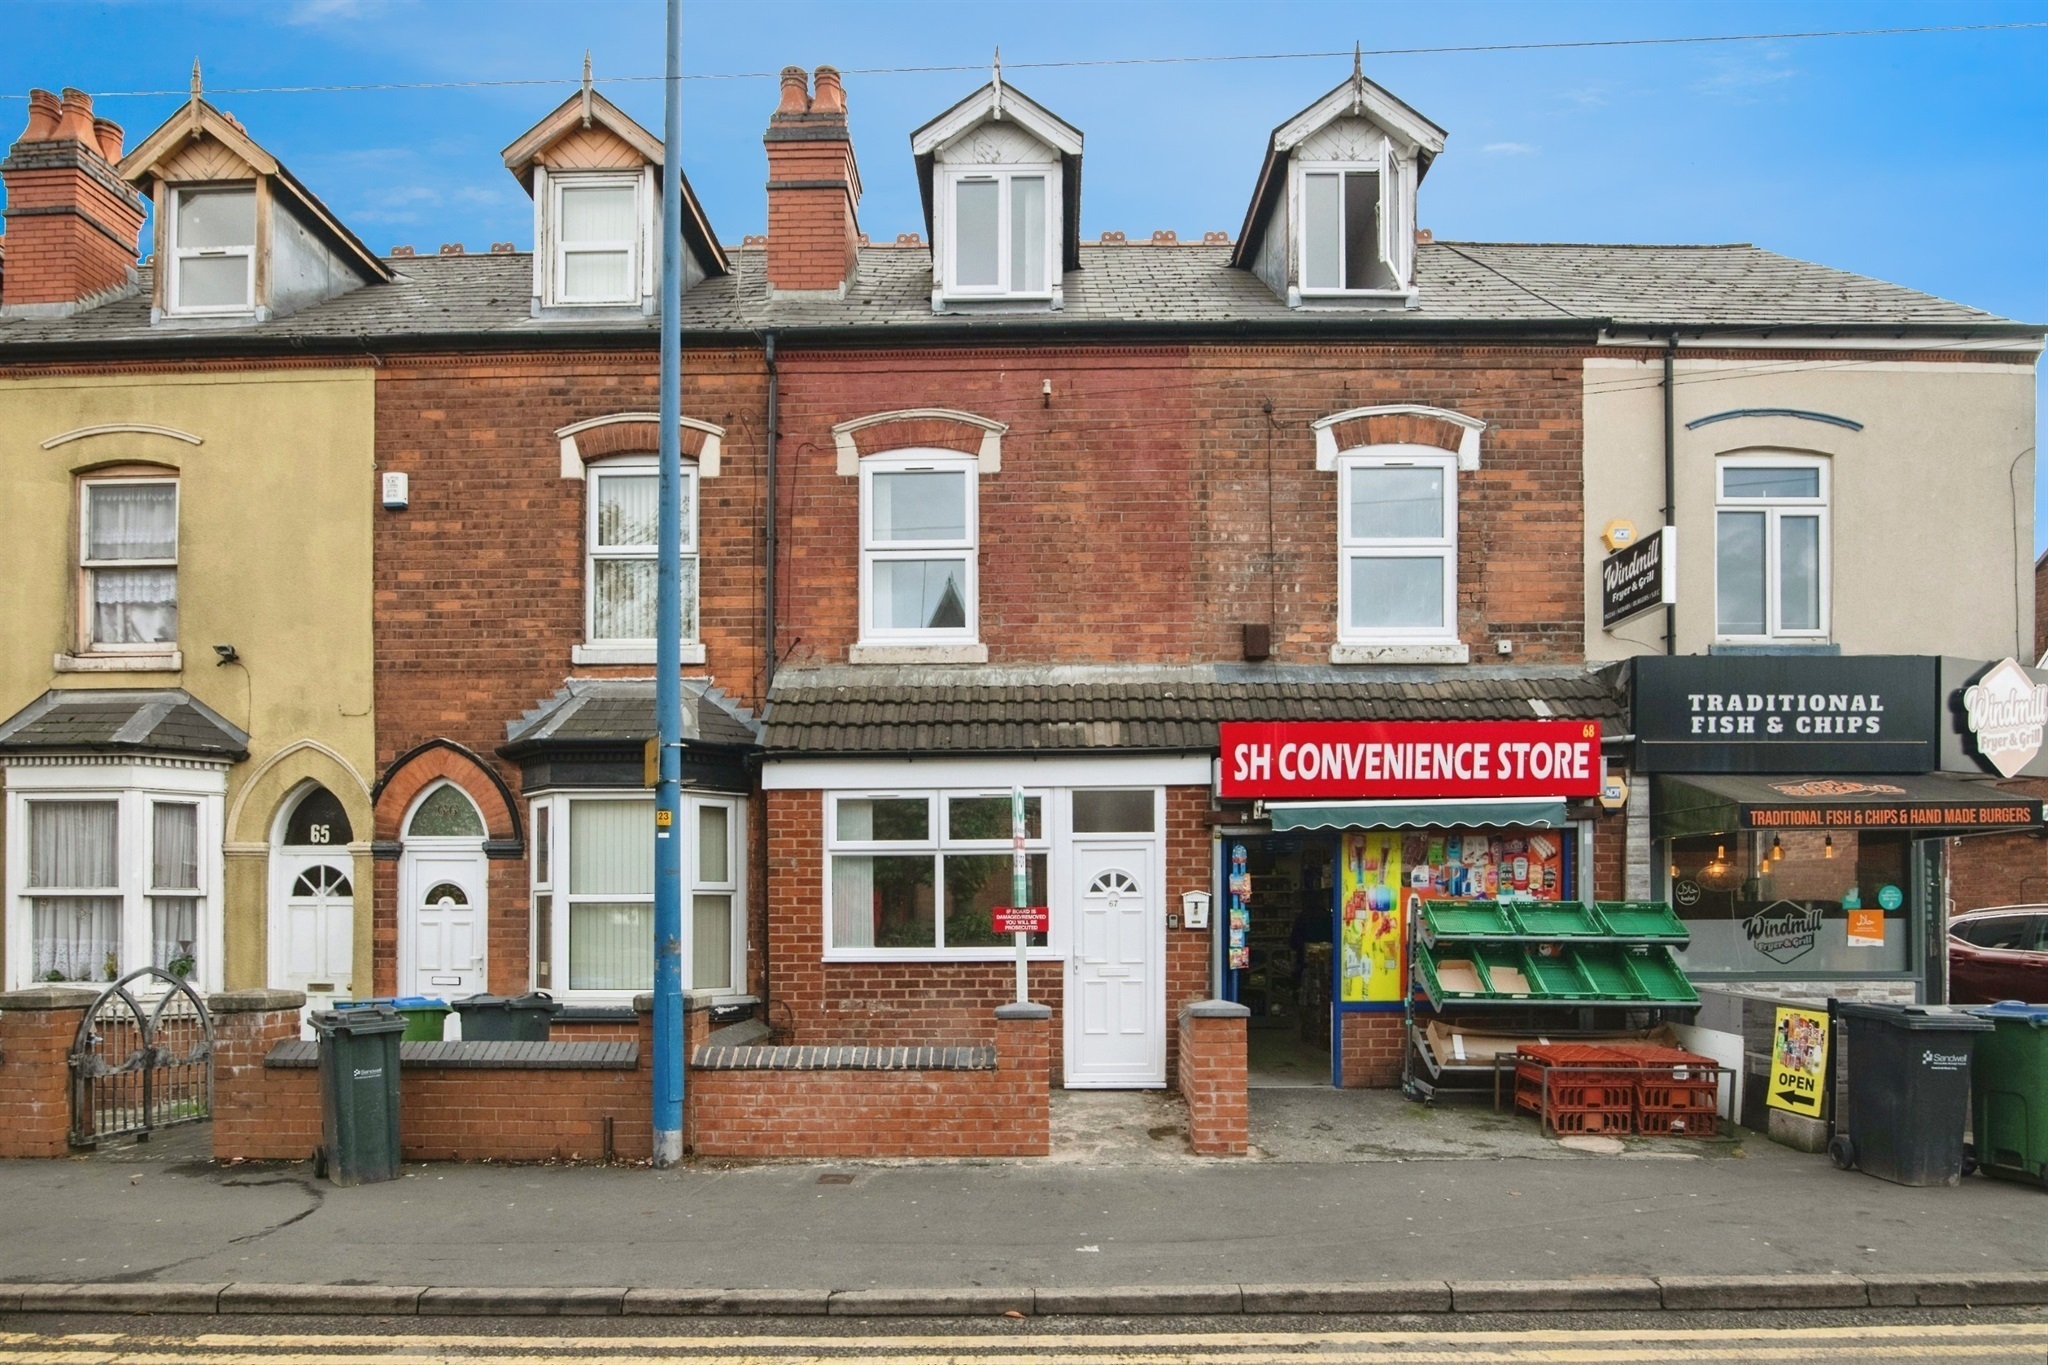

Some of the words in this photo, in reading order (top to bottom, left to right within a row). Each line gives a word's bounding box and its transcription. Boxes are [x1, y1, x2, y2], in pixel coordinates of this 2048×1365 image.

[1604, 537, 1660, 592] Windmill
[1612, 586, 1631, 603] Fryer
[1631, 581, 1638, 592] &
[1638, 569, 1655, 590] Grill
[1688, 694, 1884, 712] TRADITIONAL
[1964, 686, 2047, 731] Windmill
[1582, 724, 1595, 738] 68
[1691, 716, 1755, 734] FISH
[1766, 716, 1784, 734] &
[1795, 716, 1881, 734] CHIPS
[1981, 736, 2008, 752] Fryer
[2009, 731, 2018, 747] &
[2019, 728, 2041, 749] Grill
[1234, 743, 1271, 781] SH
[1278, 742, 1490, 781] CONVENIENCE
[1497, 742, 1590, 780] STORE
[1605, 787, 1621, 797] ADT
[437, 804, 459, 816] 66
[658, 811, 669, 821] 23
[1750, 810, 1824, 826] TRADITIONAL
[1826, 810, 1851, 825] FISH
[1854, 809, 1863, 825] &
[1865, 809, 1898, 825] CHIPS
[1899, 809, 1907, 824] &
[1910, 808, 1942, 824] HAND
[1944, 808, 1977, 823] MADE
[1980, 807, 2031, 823] BURGERS
[310, 824, 330, 844] 65
[1109, 899, 1118, 907] 67
[1742, 909, 1823, 941] Windmill
[1757, 941, 1783, 953] Fryer
[1784, 938, 1793, 949] &
[1793, 935, 1813, 949] Grill
[1933, 1053, 1967, 1062] Sandwell
[1778, 1072, 1815, 1092] OPEN
